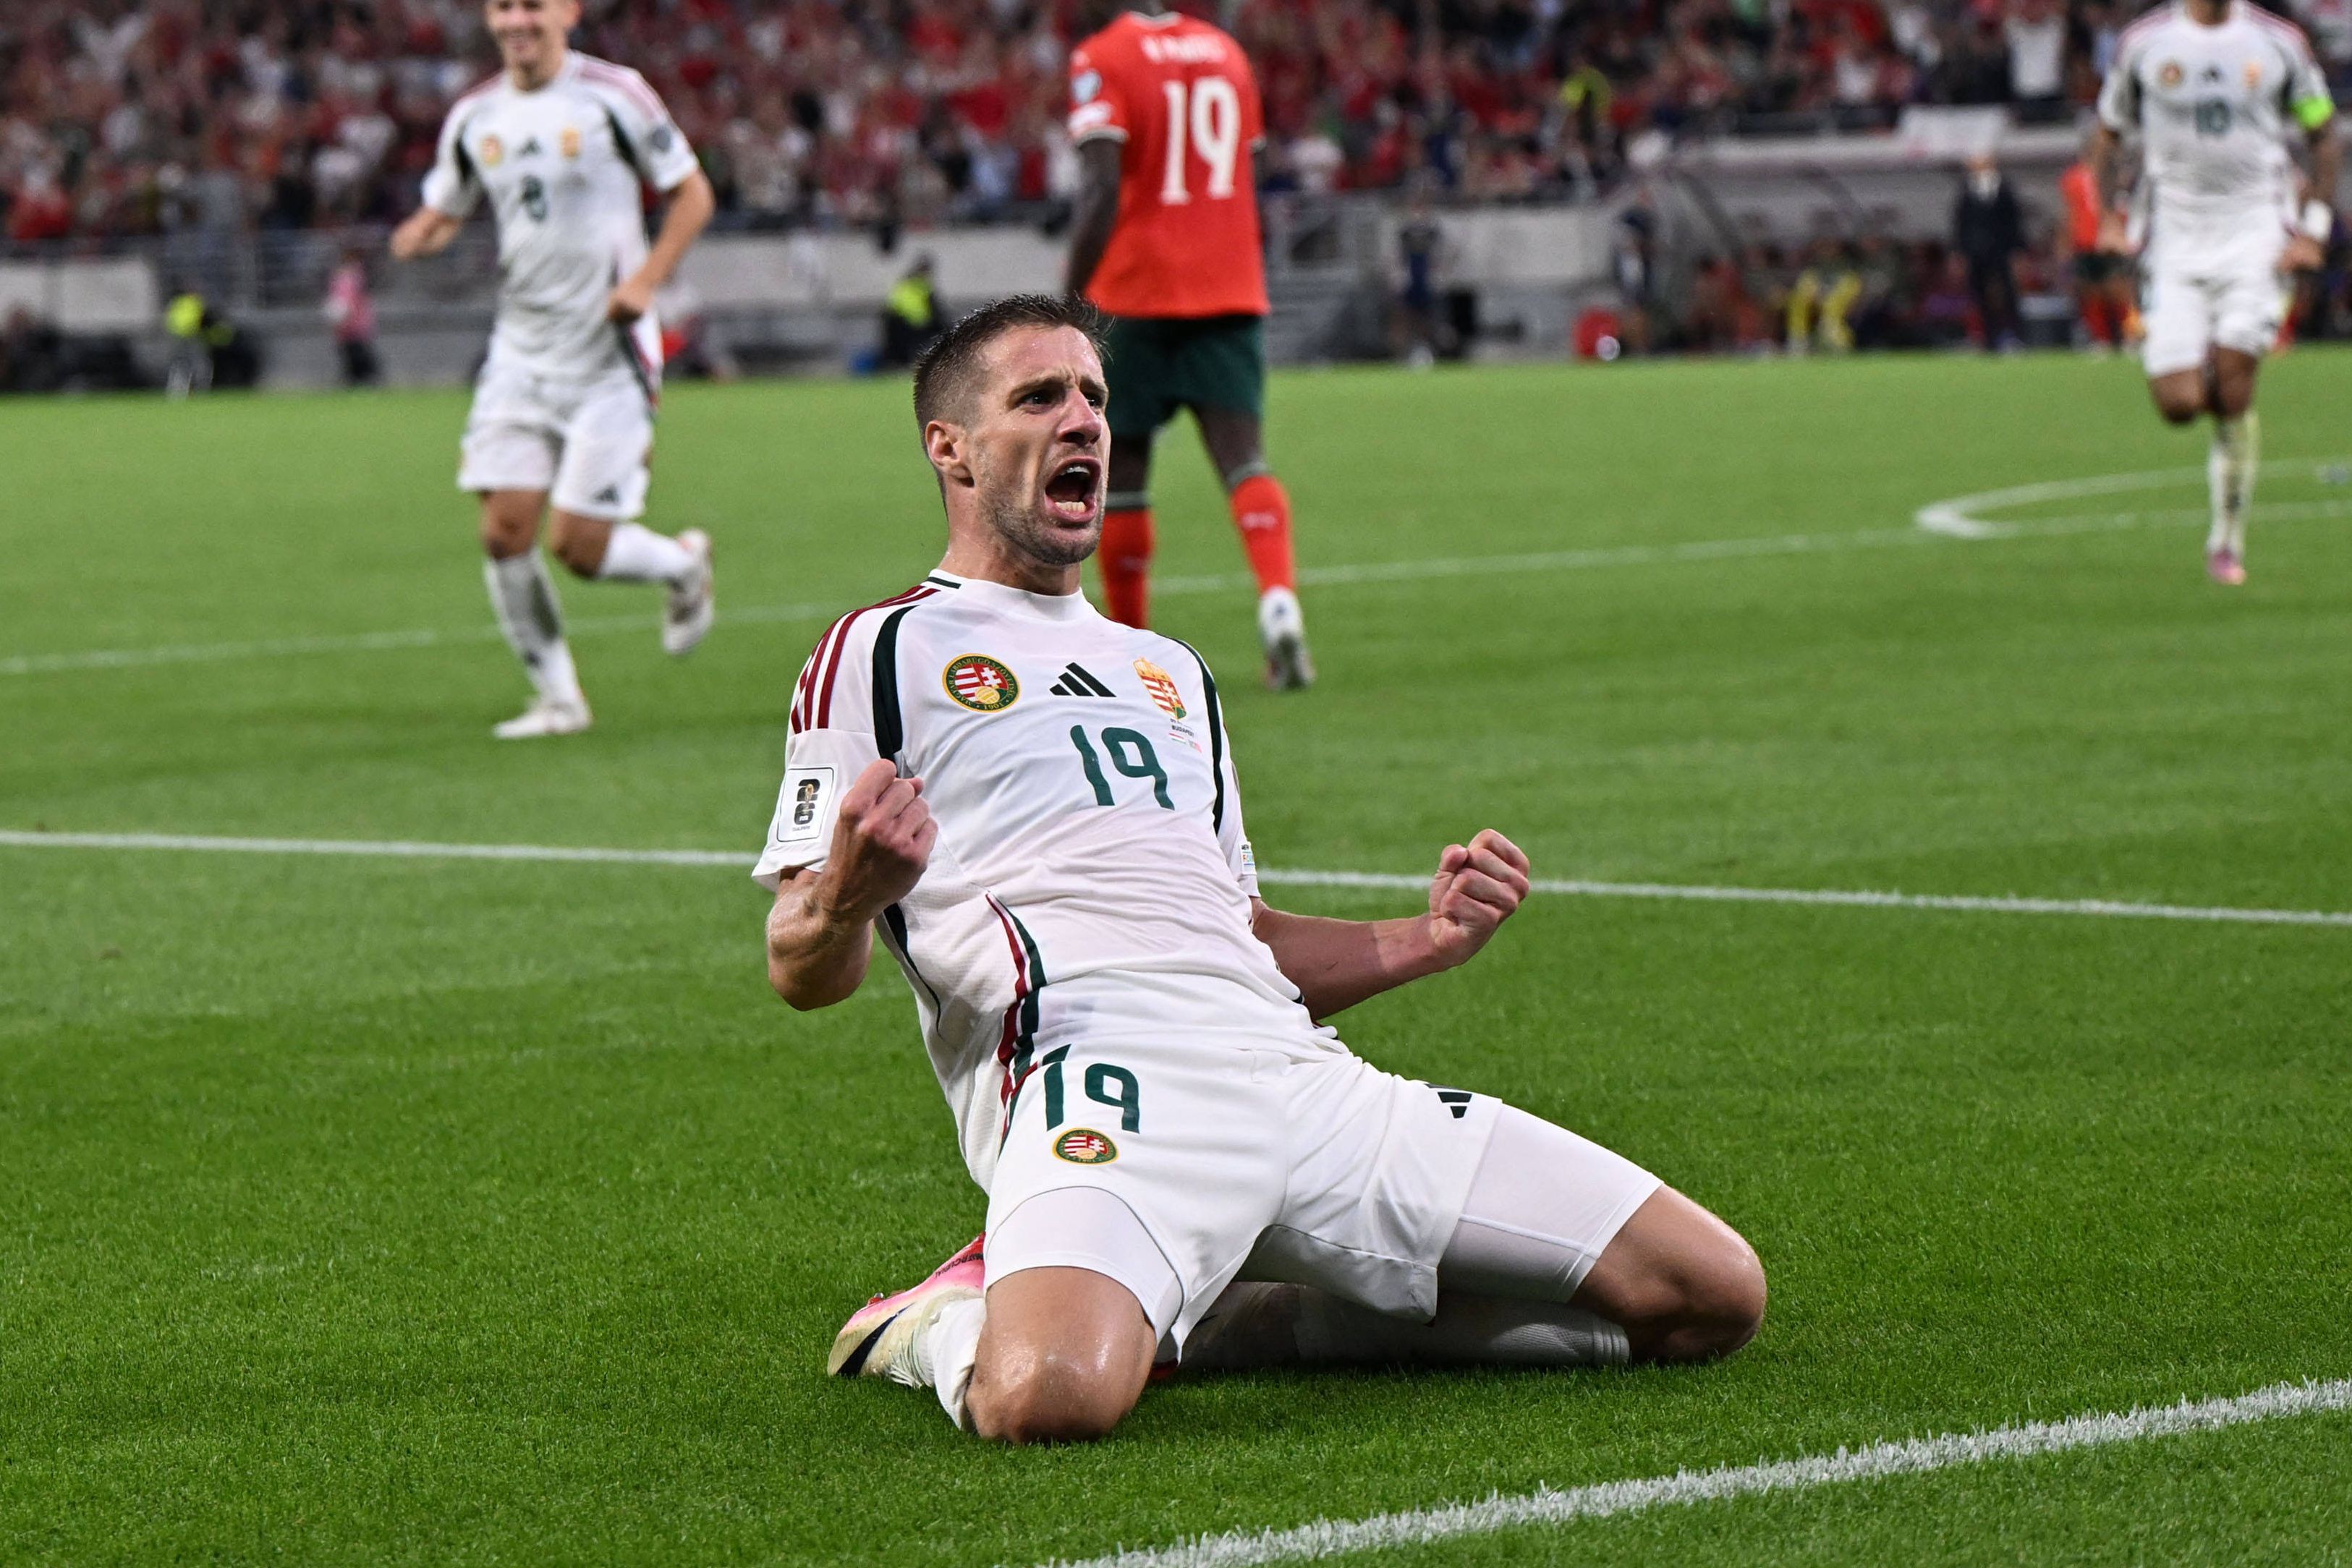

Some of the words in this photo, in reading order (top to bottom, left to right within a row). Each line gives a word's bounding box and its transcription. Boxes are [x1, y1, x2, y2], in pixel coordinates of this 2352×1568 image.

[1160, 77, 1241, 205] 19
[1070, 724, 1175, 811] 19
[1042, 1043, 1140, 1134] 19
